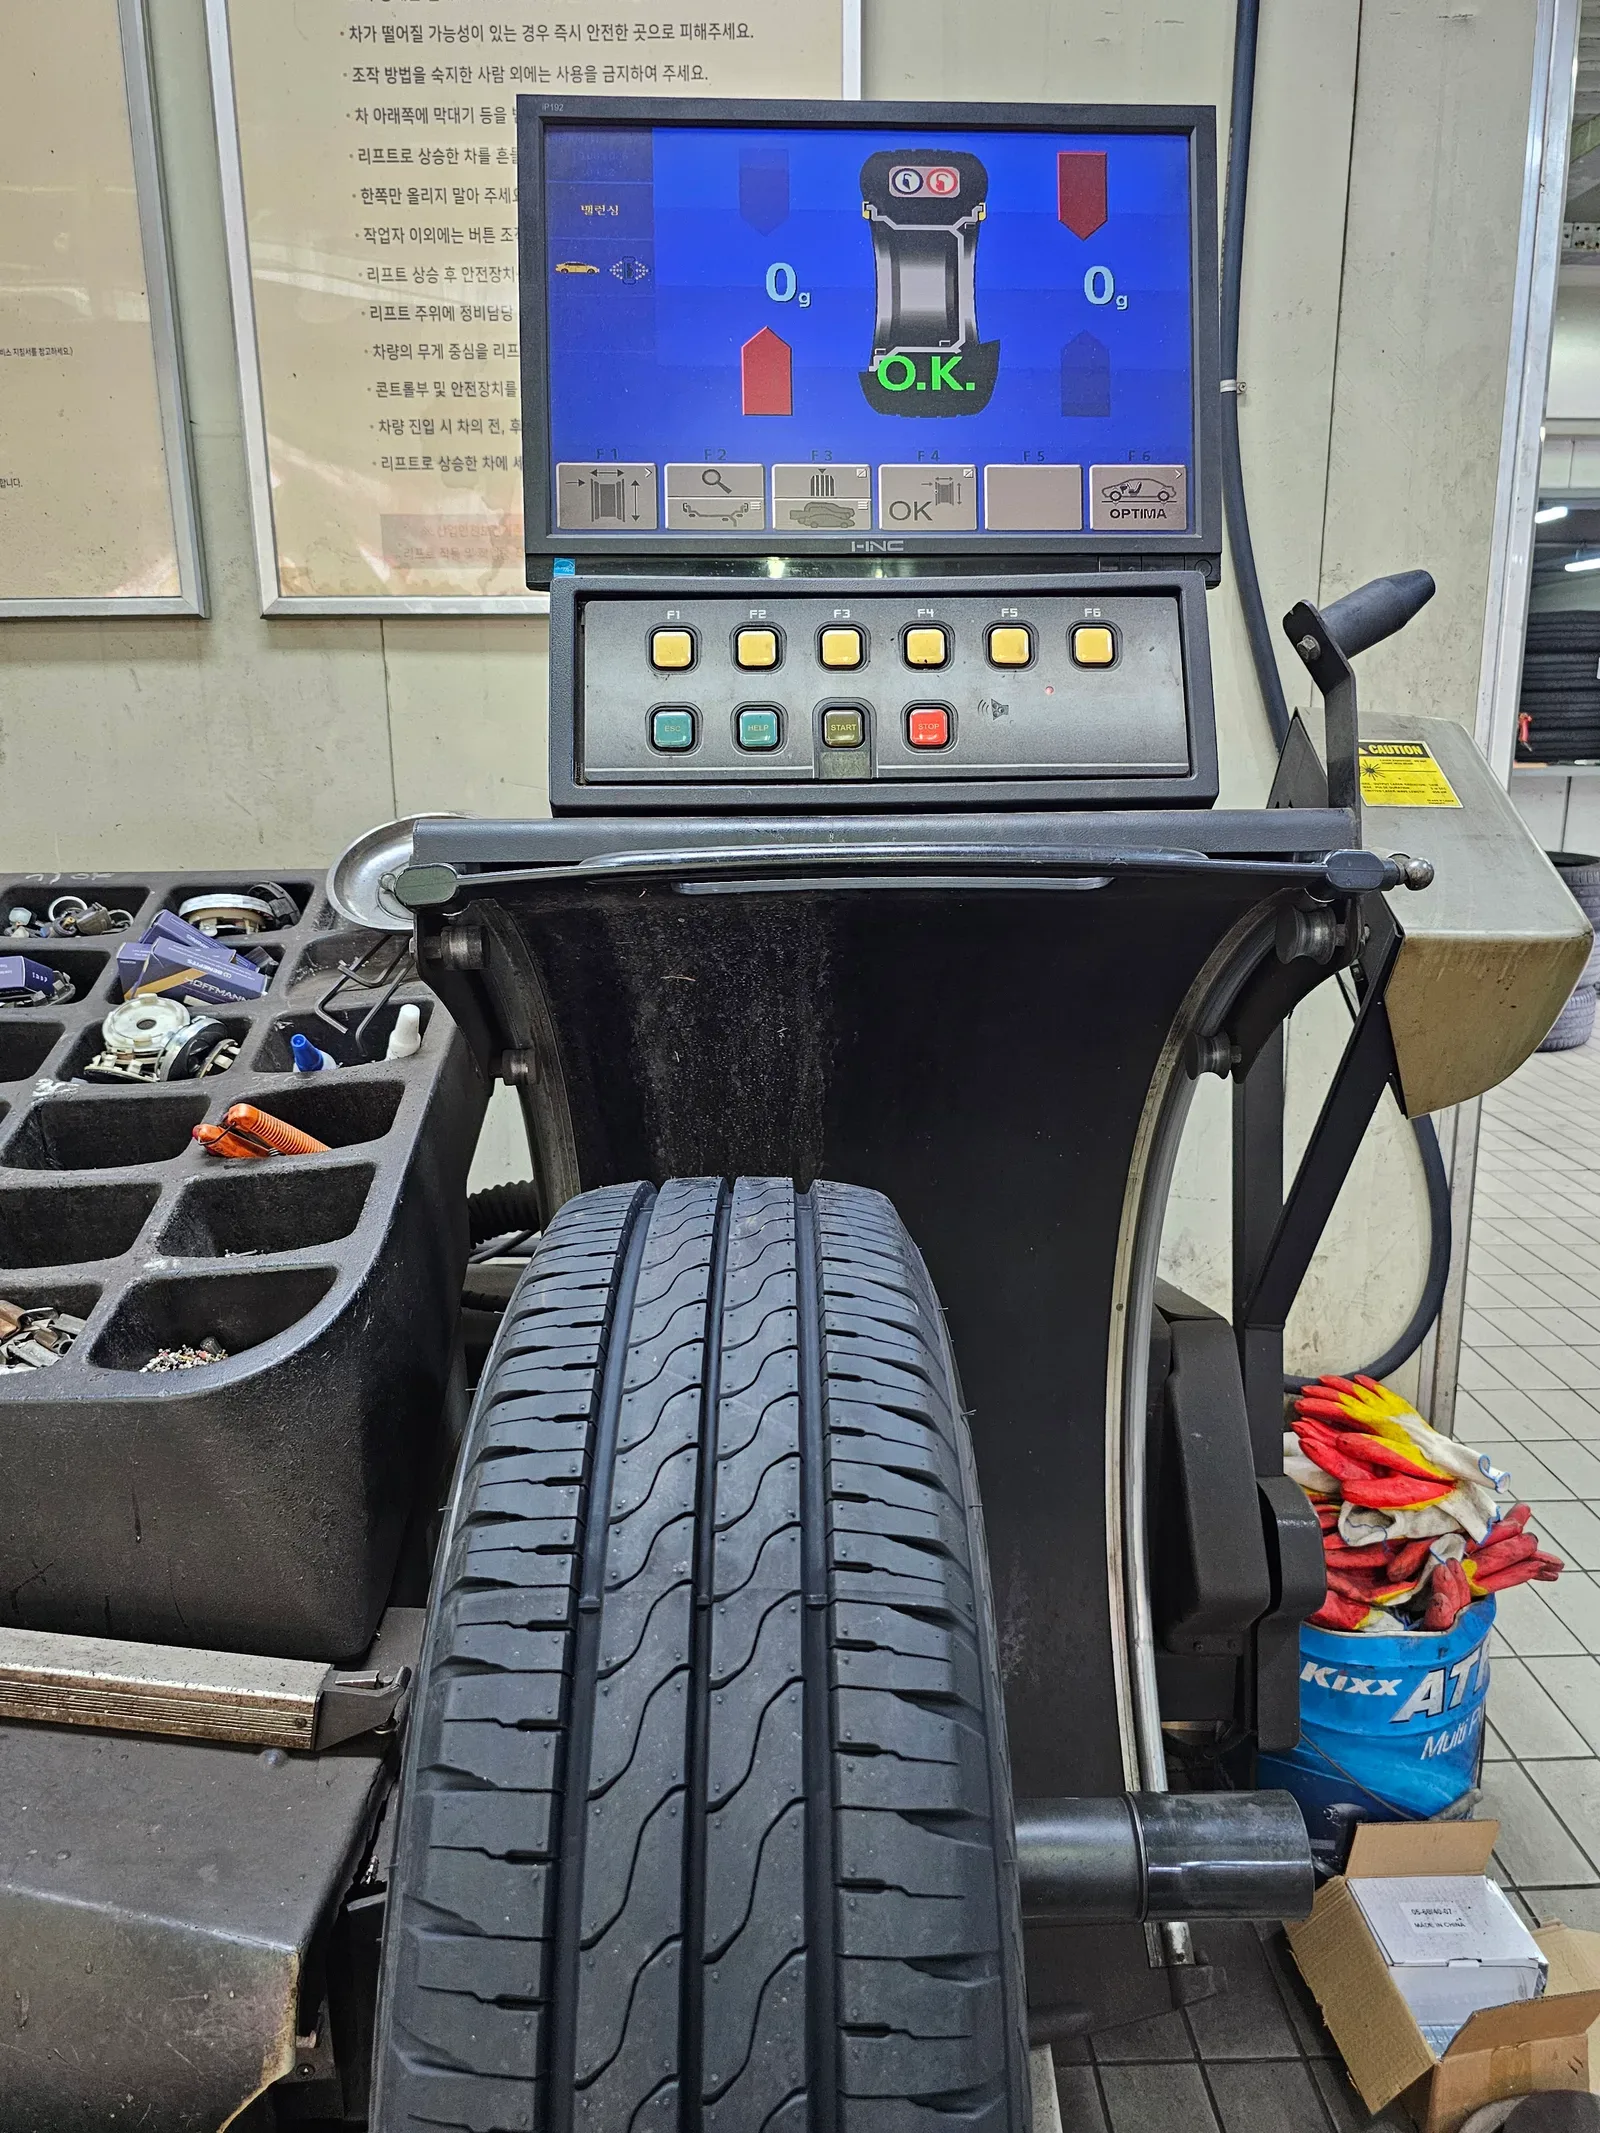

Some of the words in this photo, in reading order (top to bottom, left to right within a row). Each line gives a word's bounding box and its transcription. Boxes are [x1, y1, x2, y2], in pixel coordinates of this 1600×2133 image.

[349, 25, 377, 43] 차가
[382, 25, 423, 43] 떨어질
[429, 25, 484, 43] 가능성이
[489, 24, 517, 42] 있는
[522, 24, 549, 42] 경우
[554, 24, 581, 42] 즉시
[587, 24, 628, 42] 안전한
[633, 24, 675, 41] 곳으로
[680, 23, 754, 41] 피해주세요.
[352, 66, 380, 84] 조작
[384, 66, 426, 84] 방법을
[431, 66, 472, 84] 숙지한
[478, 66, 505, 83] 사람
[510, 65, 551, 83] 외에는
[556, 65, 598, 83] 사용을
[602, 65, 657, 83] 금지하여
[662, 64, 708, 82] 주세요.
[355, 107, 368, 124] 차
[373, 107, 429, 124] 아래쪽에
[434, 107, 474, 124] 막대기
[480, 107, 507, 124] 등을
[358, 147, 414, 164] 리프트로
[418, 147, 459, 164] 상승한
[464, 147, 491, 164] 차를
[361, 188, 401, 204] 한쪽만
[407, 188, 447, 204] 올리지
[453, 188, 480, 204] 말아
[580, 204, 619, 216] 밸런싱
[364, 227, 405, 244] 작업자
[410, 227, 464, 244] 이외에는
[469, 227, 496, 244] 버튼
[500, 227, 518, 244] 조
[367, 266, 408, 283] 리프트
[413, 266, 439, 283] 상승
[444, 266, 457, 283] 후
[370, 305, 411, 321] 리프트
[415, 305, 455, 321] 주위에
[460, 305, 513, 321] 정비담당
[373, 343, 412, 360] 차량의
[418, 343, 444, 360] 무게
[448, 343, 488, 360] 중심을
[877, 355, 975, 391] O.K.
[376, 381, 429, 398] 콘트롤부
[434, 381, 446, 398] 및
[451, 381, 518, 398] 안전장치를
[379, 419, 404, 435] 차량
[409, 419, 435, 435] 진입
[440, 419, 452, 435] 시
[457, 419, 483, 435] 차의
[488, 419, 505, 435] 전,
[381, 456, 434, 472] 리프트로
[439, 456, 478, 472] 상승한
[482, 456, 508, 472] 차에
[889, 500, 933, 522] OK
[1110, 508, 1167, 520] OPTIMA
[667, 610, 681, 620] F1
[749, 609, 767, 619] F2
[833, 609, 851, 619] F3
[917, 608, 934, 618] F4
[1001, 608, 1018, 617] F5
[1084, 608, 1101, 617] F6
[664, 724, 681, 732] ESC
[748, 724, 769, 732] HELP
[830, 723, 856, 732] START
[918, 722, 939, 730] STOP
[1368, 744, 1423, 755] CAUTION
[1300, 1661, 1402, 1696] Kixx
[1420, 1718, 1468, 1761] Multi
